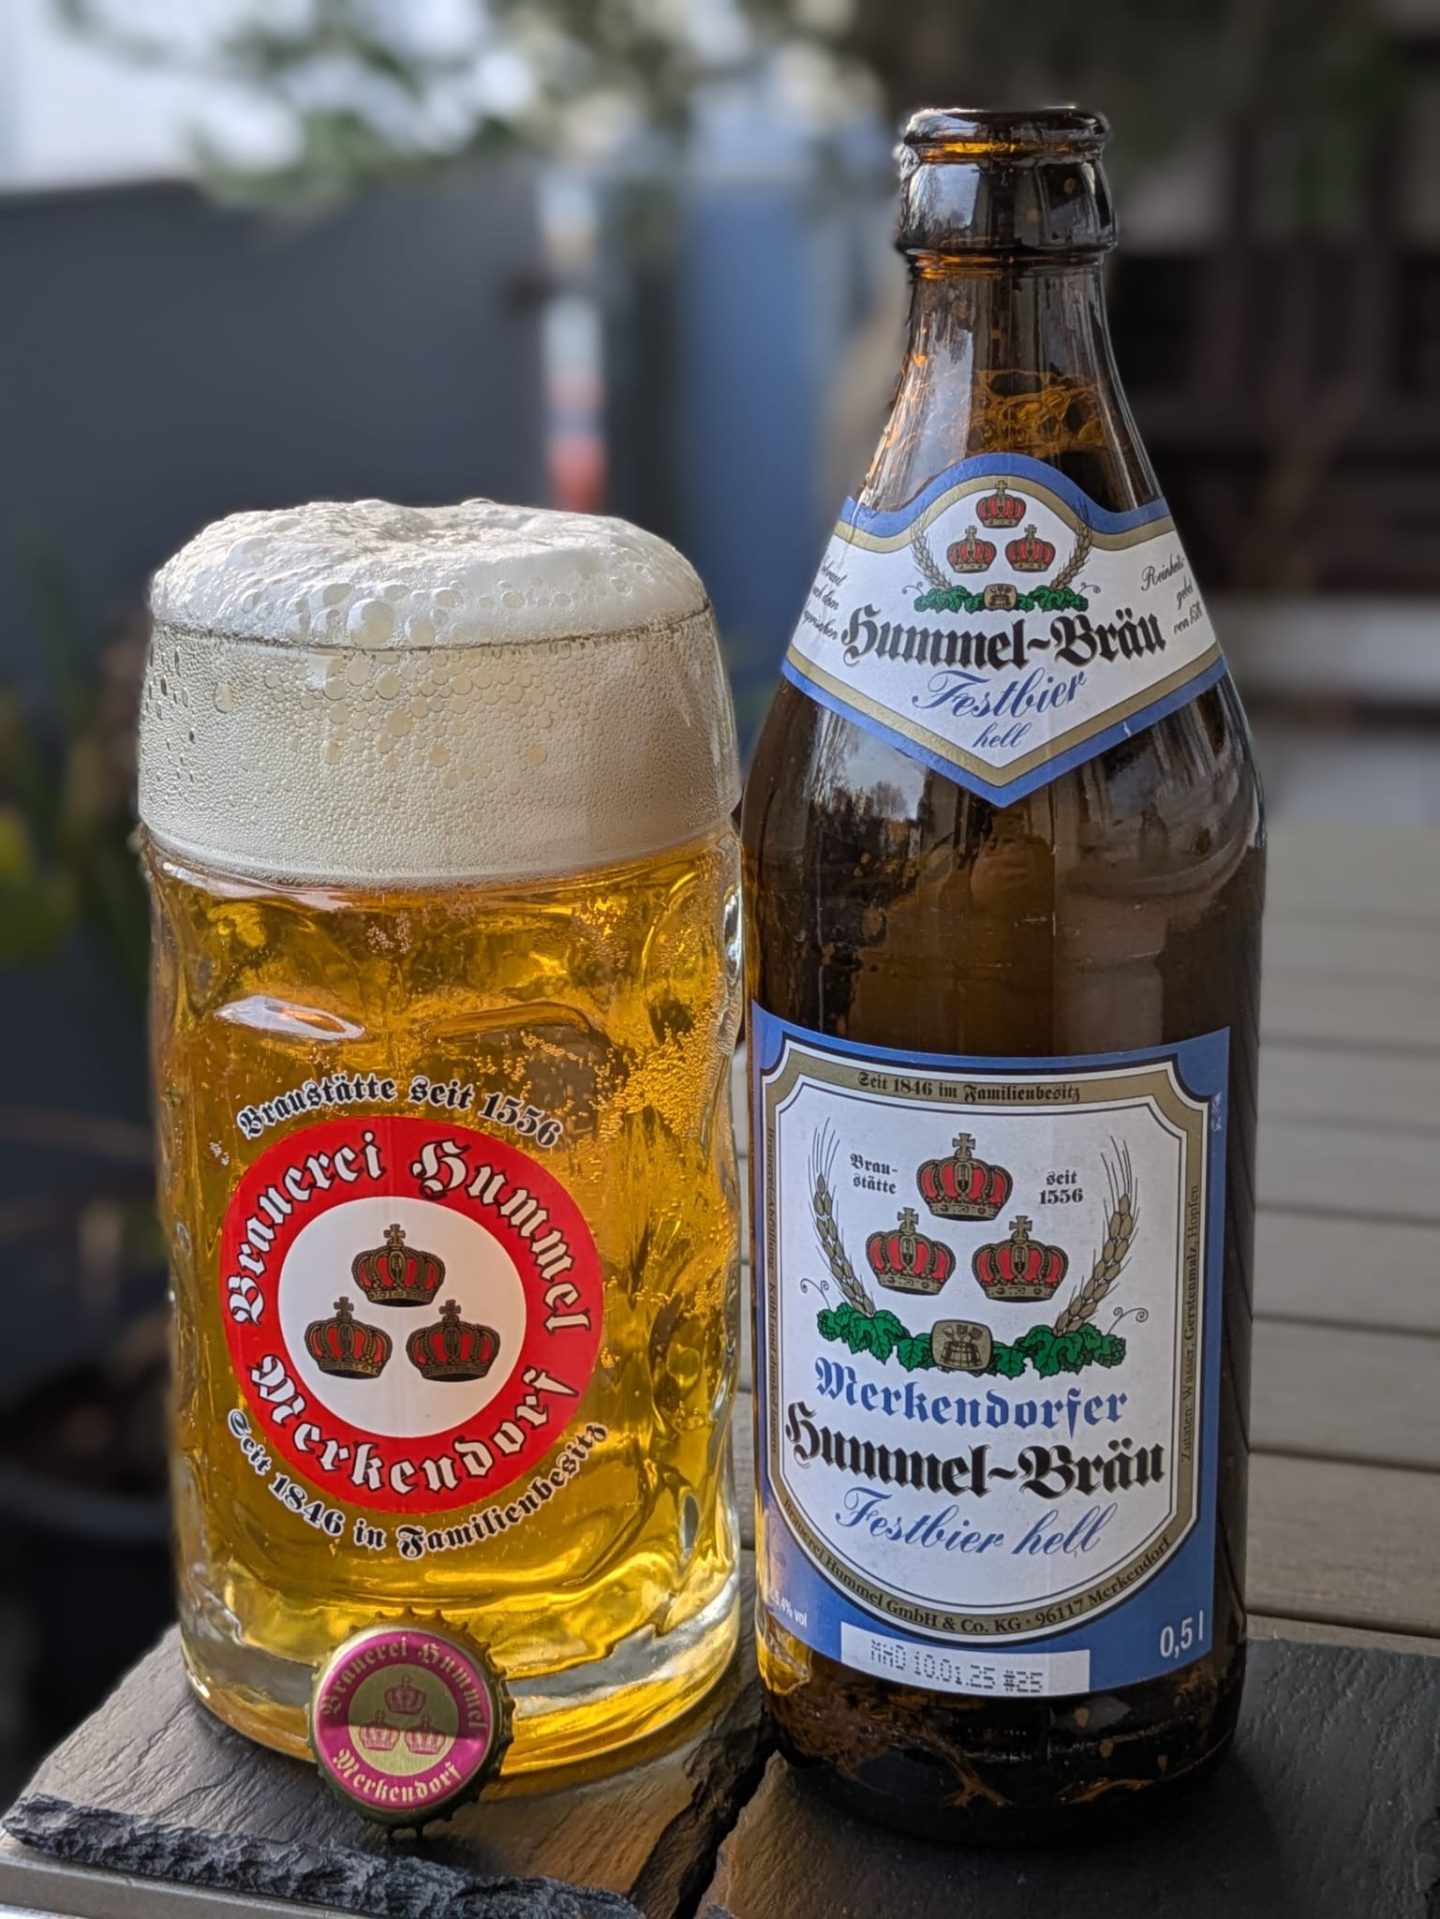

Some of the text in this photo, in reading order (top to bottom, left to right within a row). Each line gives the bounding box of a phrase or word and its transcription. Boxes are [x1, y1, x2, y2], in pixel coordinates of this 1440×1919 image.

[840, 604, 1167, 672] Hummel-Bräu
[911, 666, 1088, 719] Festbier
[971, 721, 1034, 750] hell
[237, 1073, 564, 1147] Braustätte seit 1556
[857, 1071, 888, 1090] Seit
[893, 1078, 933, 1098] 1846
[962, 1084, 1081, 1104] Familienbesitz
[849, 1153, 899, 1177] Brau-
[851, 1173, 898, 1196] stätte
[1045, 1169, 1078, 1188] seit
[1038, 1186, 1085, 1207] 1556
[1187, 1184, 1201, 1239] Hopfen
[227, 1130, 592, 1332] Brauerei Hummel
[249, 1353, 580, 1495] Merkendorf
[814, 1356, 1129, 1440] Merkendorfer
[785, 1400, 1166, 1500] Hummel-Bräu
[227, 1407, 273, 1476] Seit
[268, 1471, 346, 1537] 1846
[396, 1421, 610, 1560] Familienbesitz
[835, 1486, 1119, 1557] Festbier hell
[783, 1499, 1173, 1635] Brauerei Hummel GmbH & Co. KG 96117 Merkendorf
[794, 1608, 807, 1629] vol
[320, 1636, 488, 1730] Brauerei Hummel
[871, 1639, 906, 1671] MHD
[914, 1651, 996, 1690] 10.01.25
[332, 1747, 463, 1803] Merkendorf
